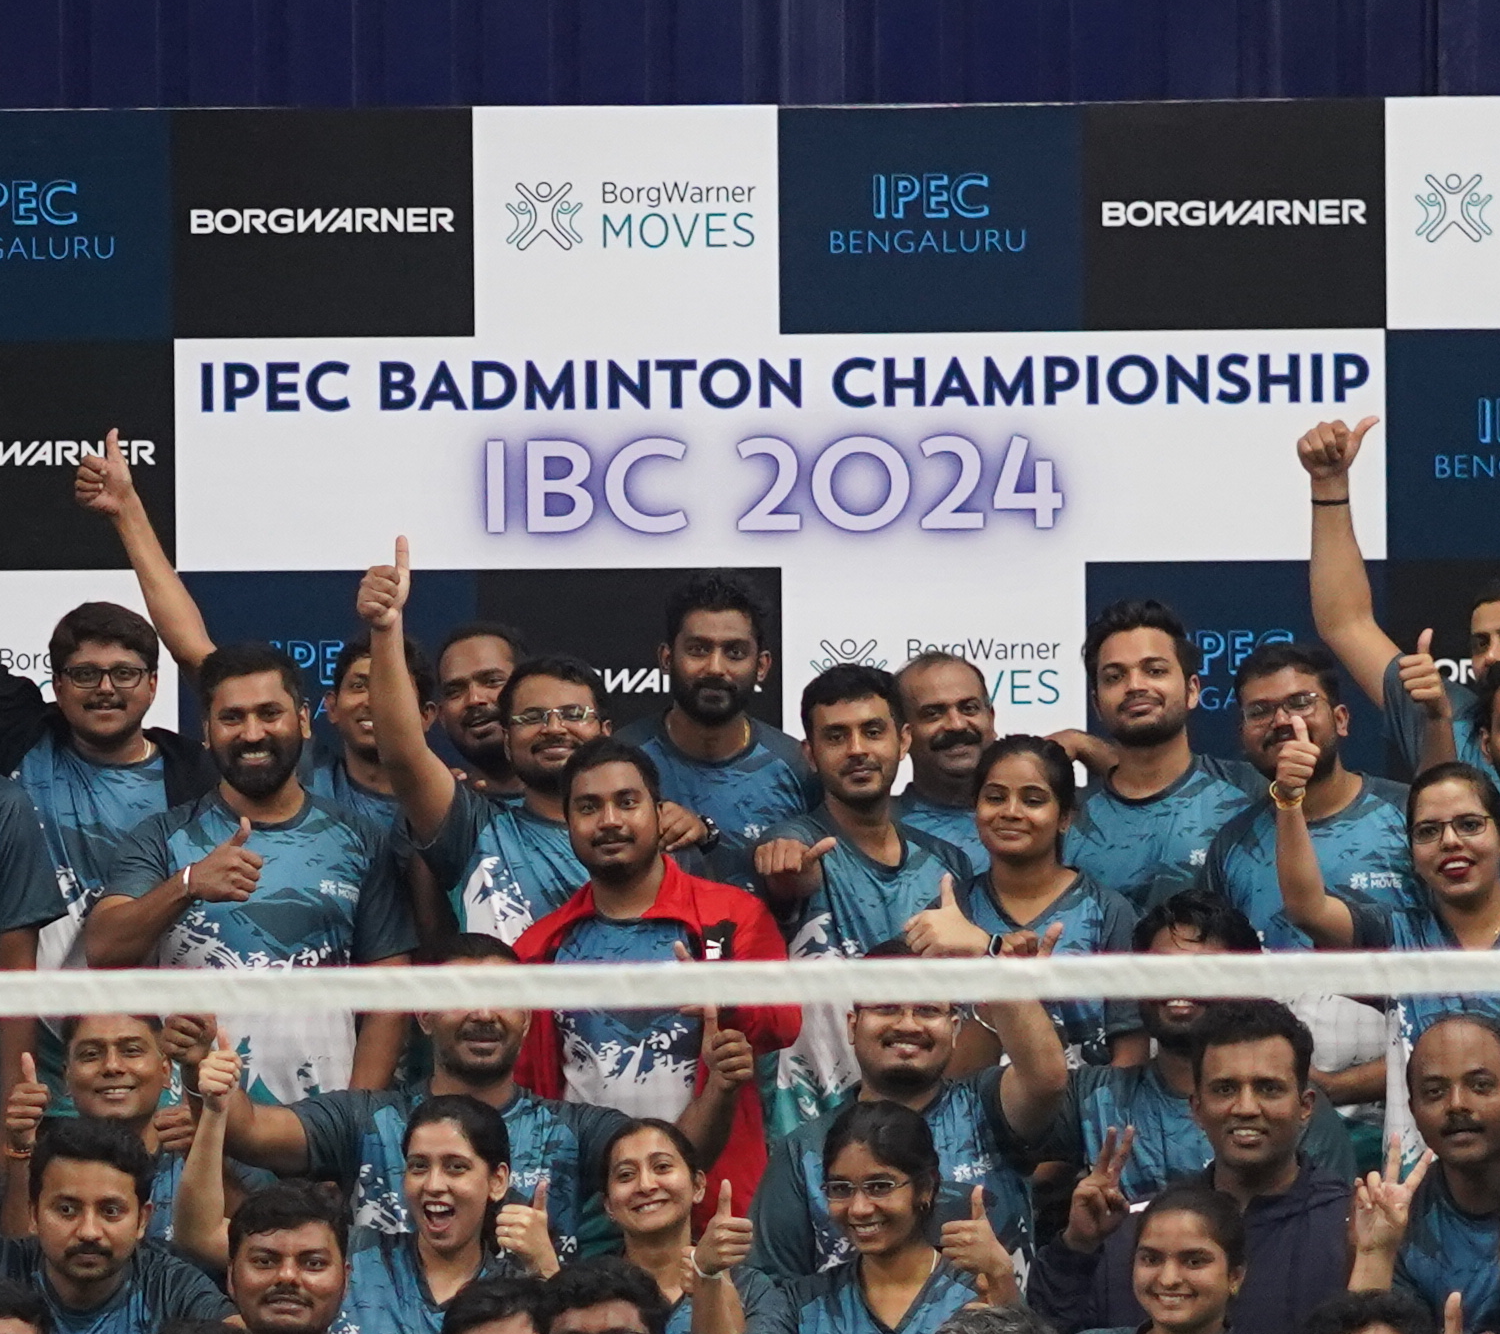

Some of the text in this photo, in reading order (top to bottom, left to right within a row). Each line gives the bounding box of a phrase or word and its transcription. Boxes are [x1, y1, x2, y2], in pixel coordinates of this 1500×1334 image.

[602, 181, 756, 205] BorgWarner
[873, 173, 989, 219] IPEC
[190, 207, 454, 235] BORGWARNER
[1101, 198, 1367, 227] BORGWARNER
[602, 212, 756, 250] MOVES
[829, 228, 1027, 254] BENGALURU
[201, 351, 1371, 412] IPEC BADMINTON CHAMPIONSHIP
[485, 433, 1065, 534] IBC 2024
